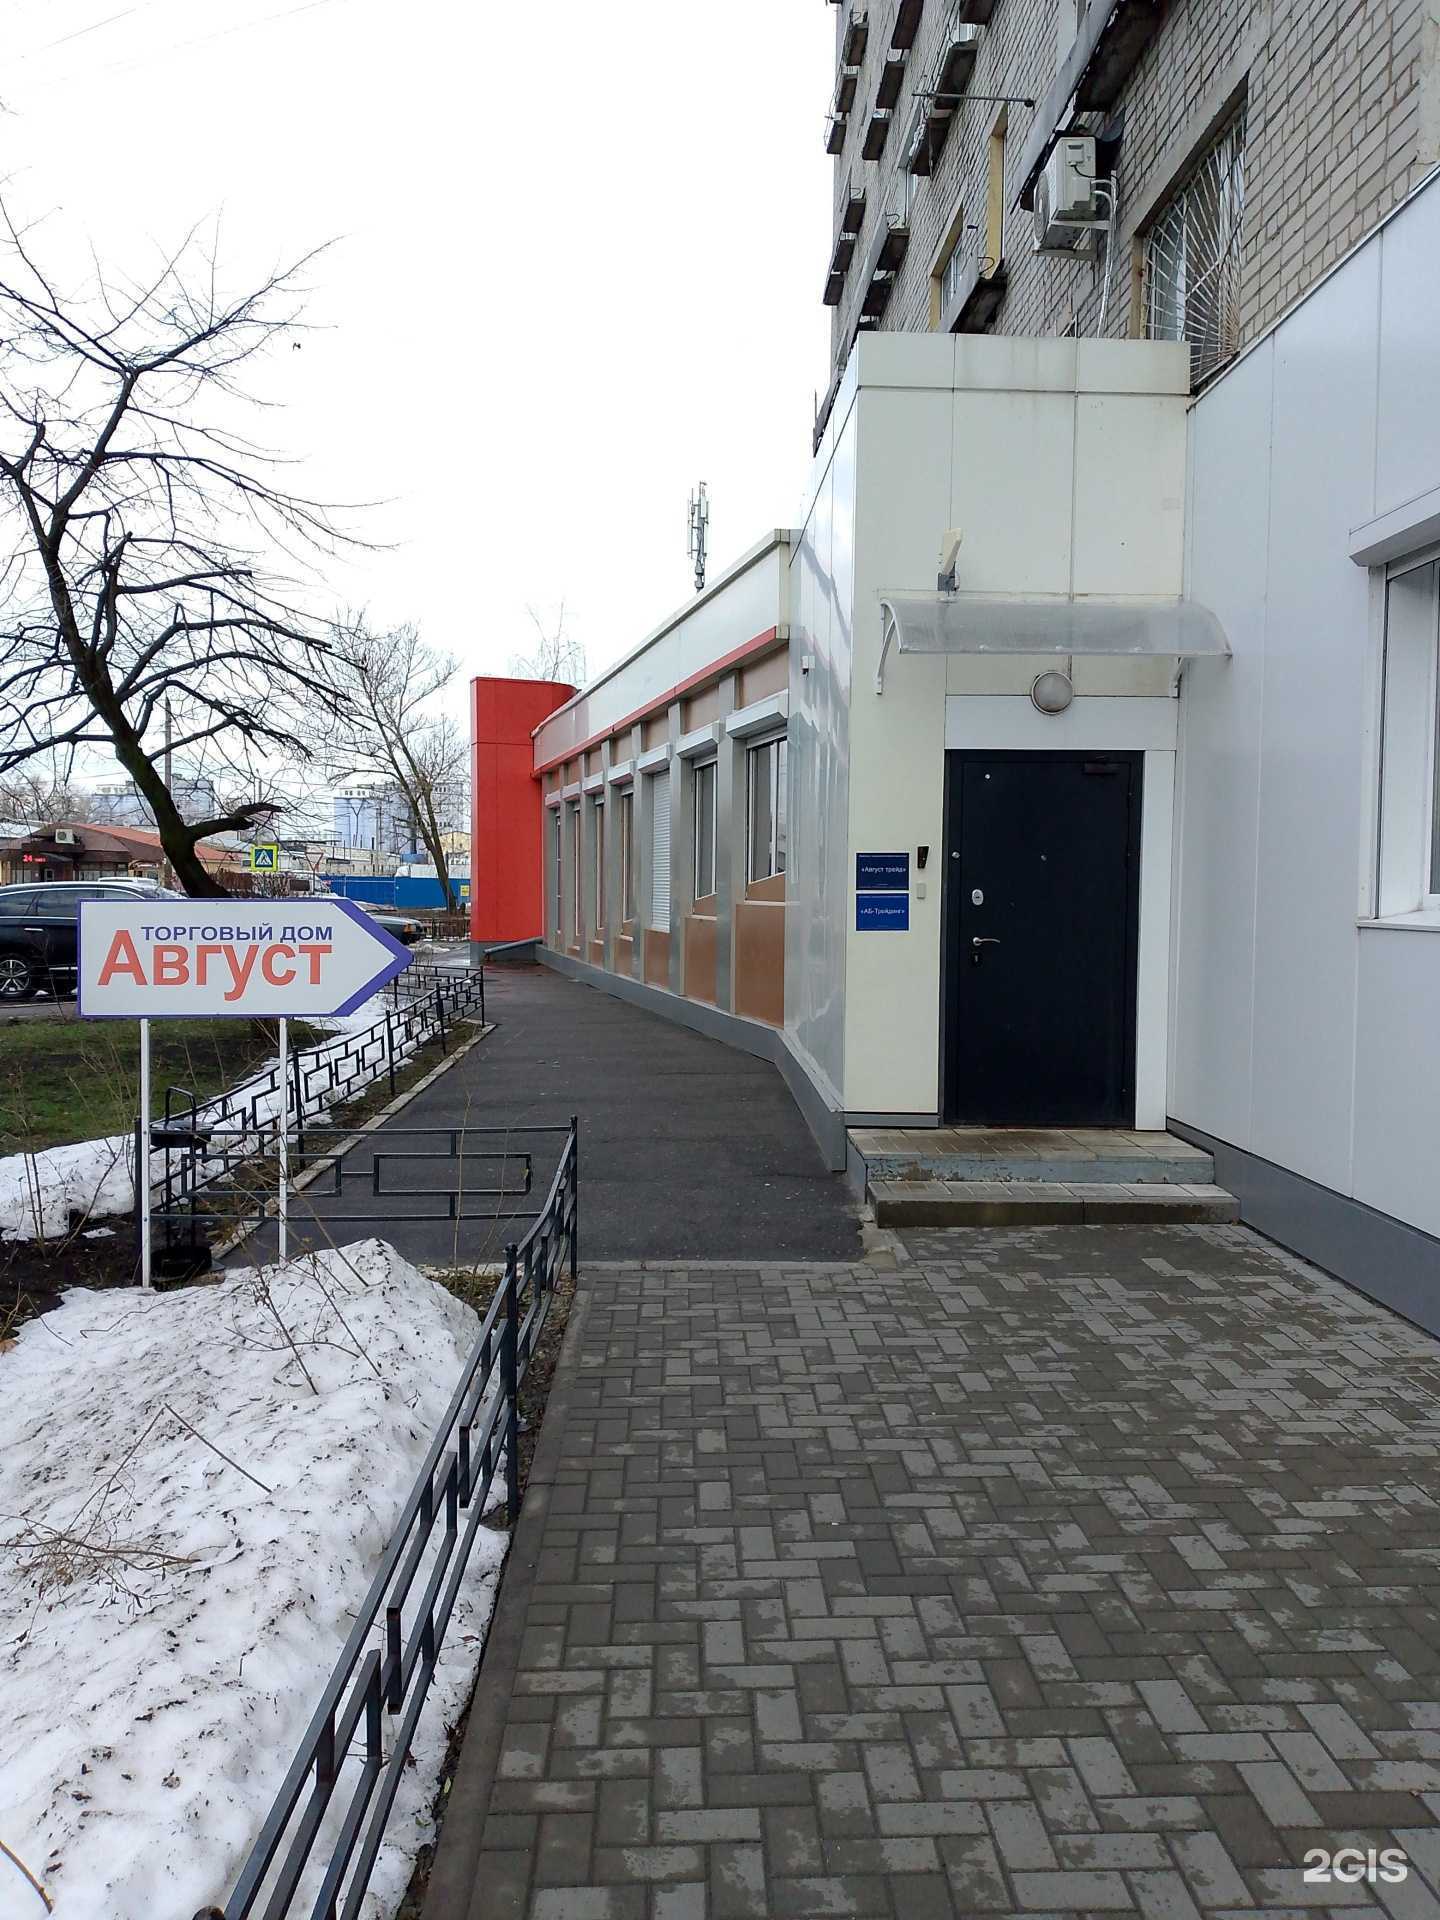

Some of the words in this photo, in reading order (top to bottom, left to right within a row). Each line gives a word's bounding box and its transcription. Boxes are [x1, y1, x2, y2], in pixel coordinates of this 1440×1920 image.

[141, 922, 273, 941] ТОРГОВЫЙ
[280, 926, 333, 943] ДОМ
[97, 929, 333, 1001] Август
